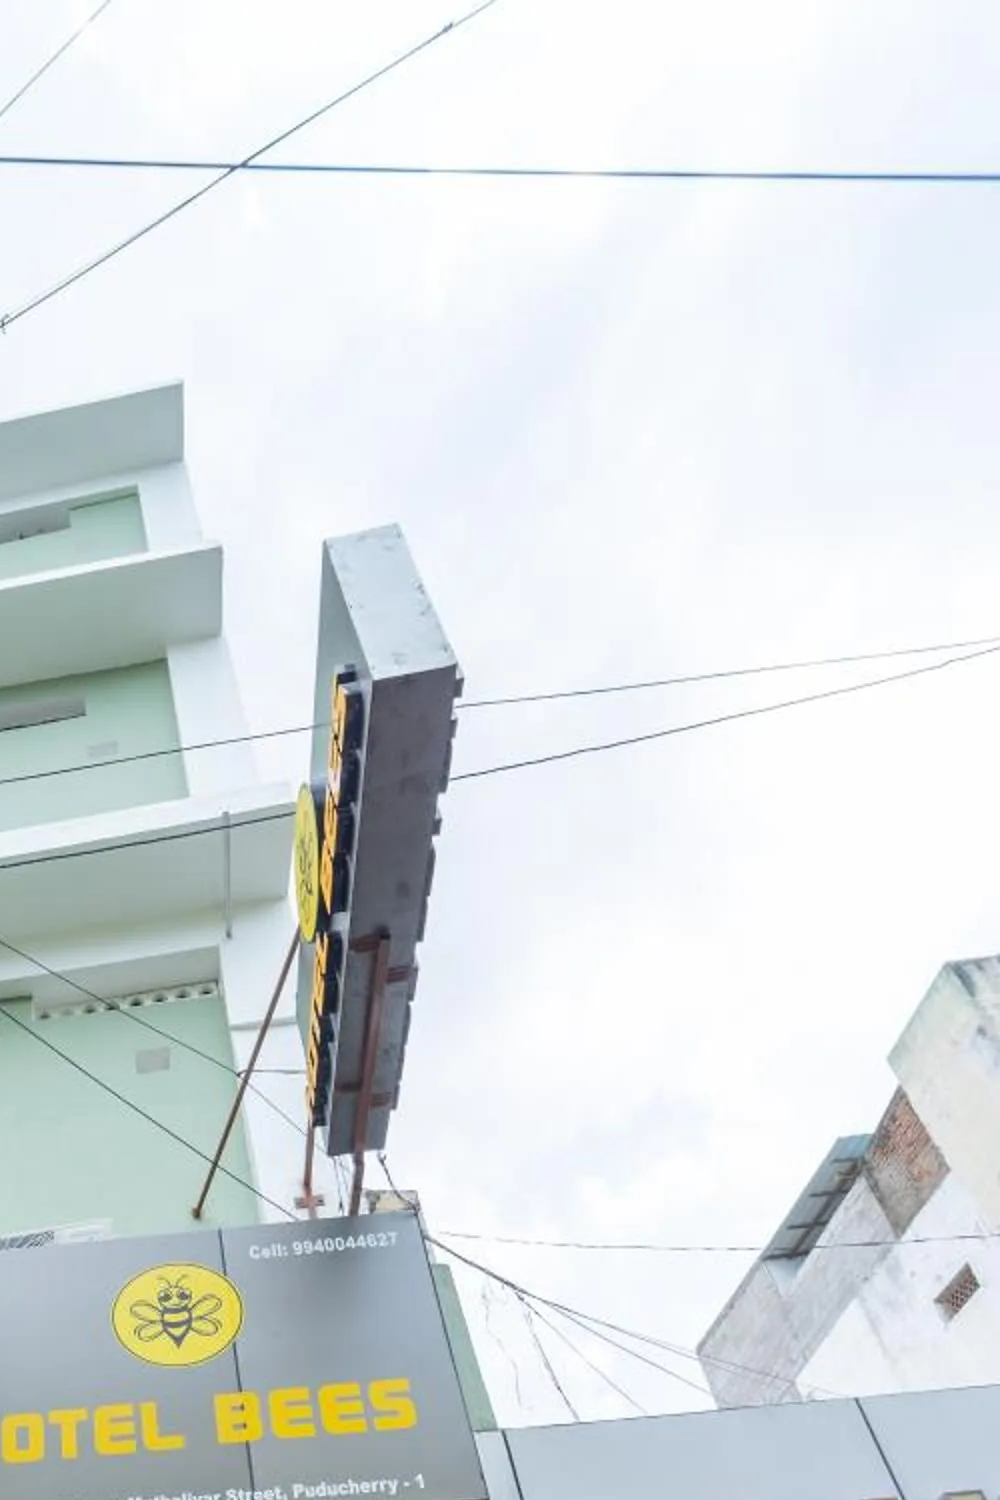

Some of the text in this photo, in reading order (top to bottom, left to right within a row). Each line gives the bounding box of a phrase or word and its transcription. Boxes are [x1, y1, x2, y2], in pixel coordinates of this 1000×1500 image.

[248, 1244, 288, 1260] Cell:
[212, 1378, 418, 1446] BEES
[292, 1474, 398, 1500] Puducherry
